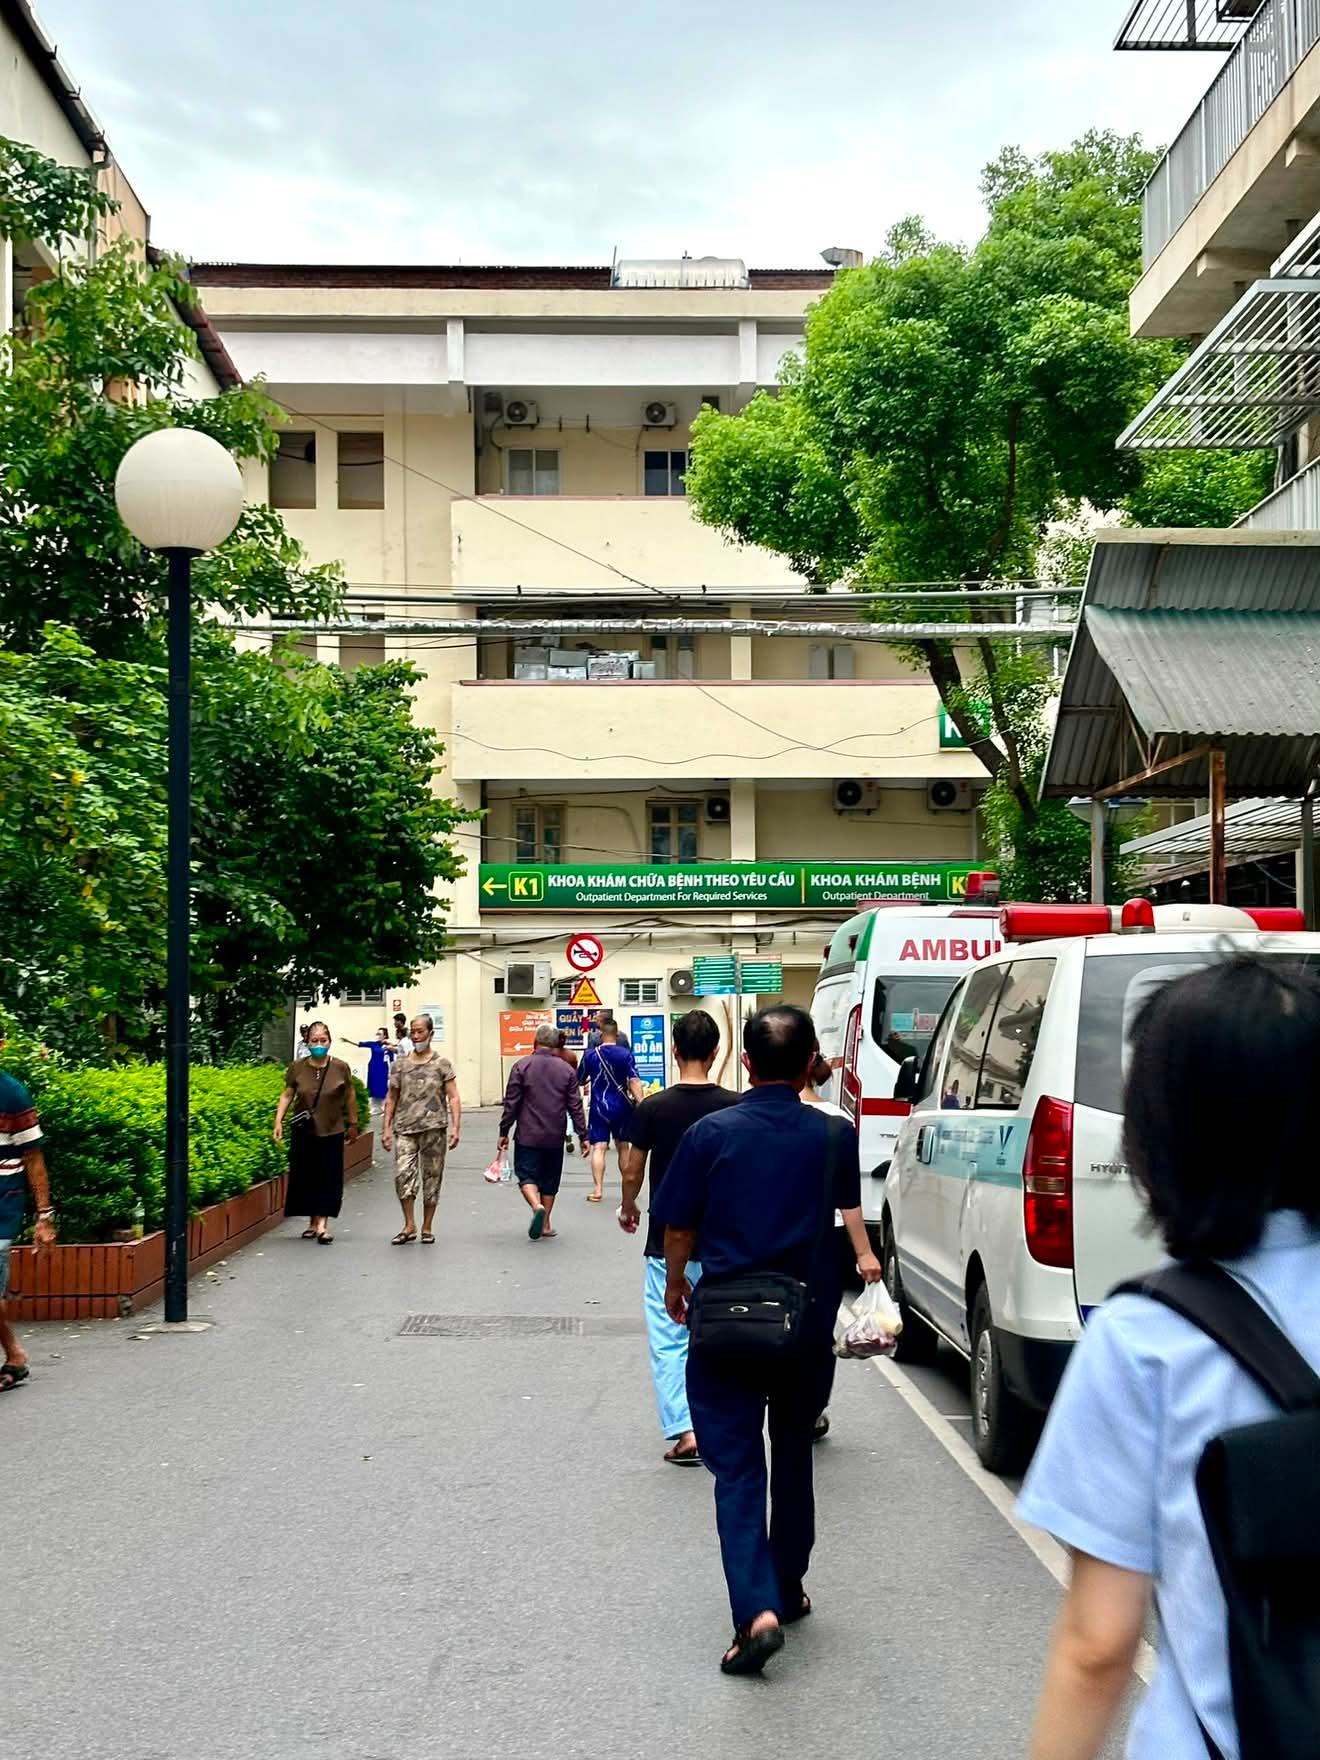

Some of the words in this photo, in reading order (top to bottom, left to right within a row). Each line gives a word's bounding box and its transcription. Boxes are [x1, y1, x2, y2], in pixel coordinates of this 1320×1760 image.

[514, 877, 538, 896] K1
[548, 875, 584, 887] KHOA
[588, 872, 626, 887] KHÁM
[628, 872, 665, 887] CHỮA
[668, 872, 702, 890] BỆNH
[704, 874, 739, 887] THEO
[742, 872, 766, 887] YÊU
[810, 874, 851, 886] KHOA
[855, 871, 898, 886] KHÁM
[902, 872, 941, 889] BỆNH
[952, 876, 966, 894] K
[576, 891, 622, 902] Outpatient
[624, 891, 676, 903] Department
[677, 891, 691, 901] For
[693, 891, 731, 902] Required
[733, 891, 768, 901] Services
[822, 891, 873, 901] Outpatient
[874, 891, 929, 900] Department
